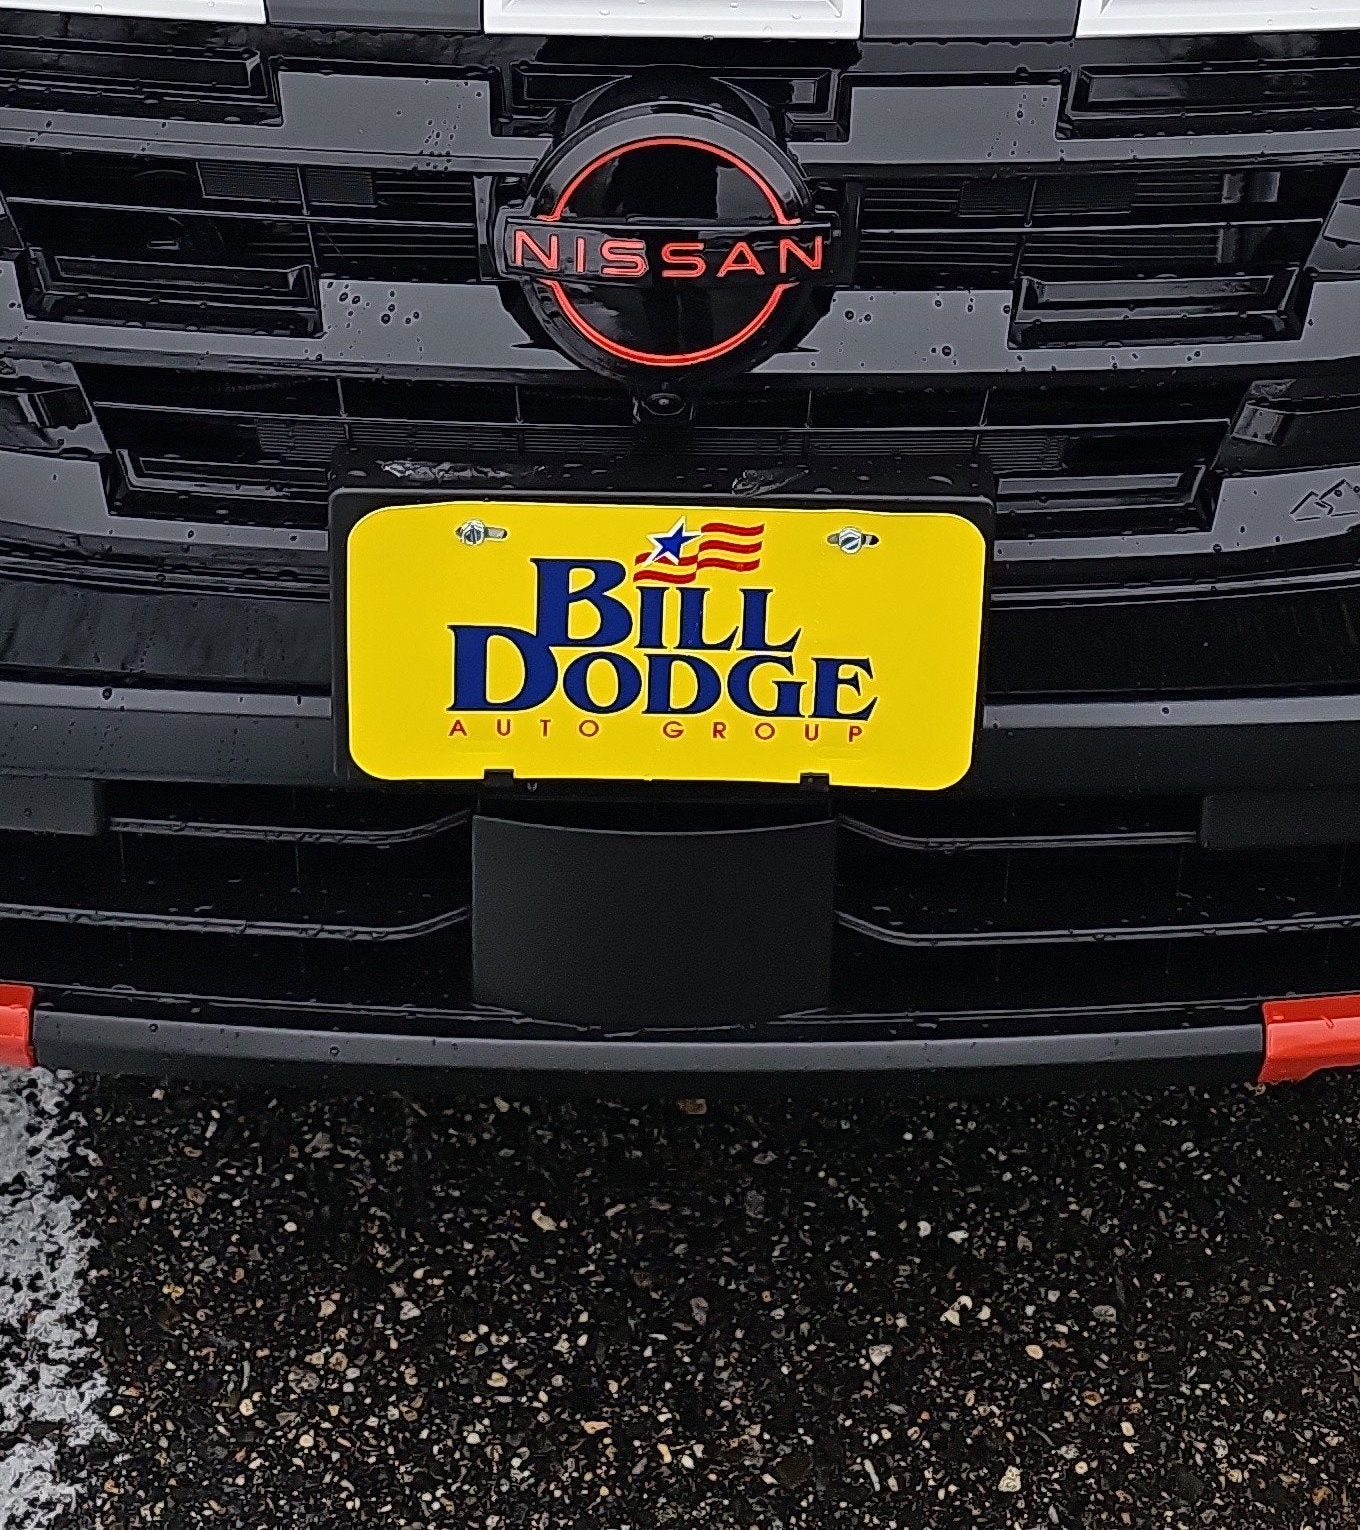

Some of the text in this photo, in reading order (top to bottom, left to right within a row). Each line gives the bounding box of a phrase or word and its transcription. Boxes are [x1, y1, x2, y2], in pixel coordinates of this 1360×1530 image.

[512, 229, 824, 278] NISSAN
[530, 557, 803, 652] BILL
[446, 624, 879, 721] DODGE
[448, 718, 865, 743] AUTO GROUP
